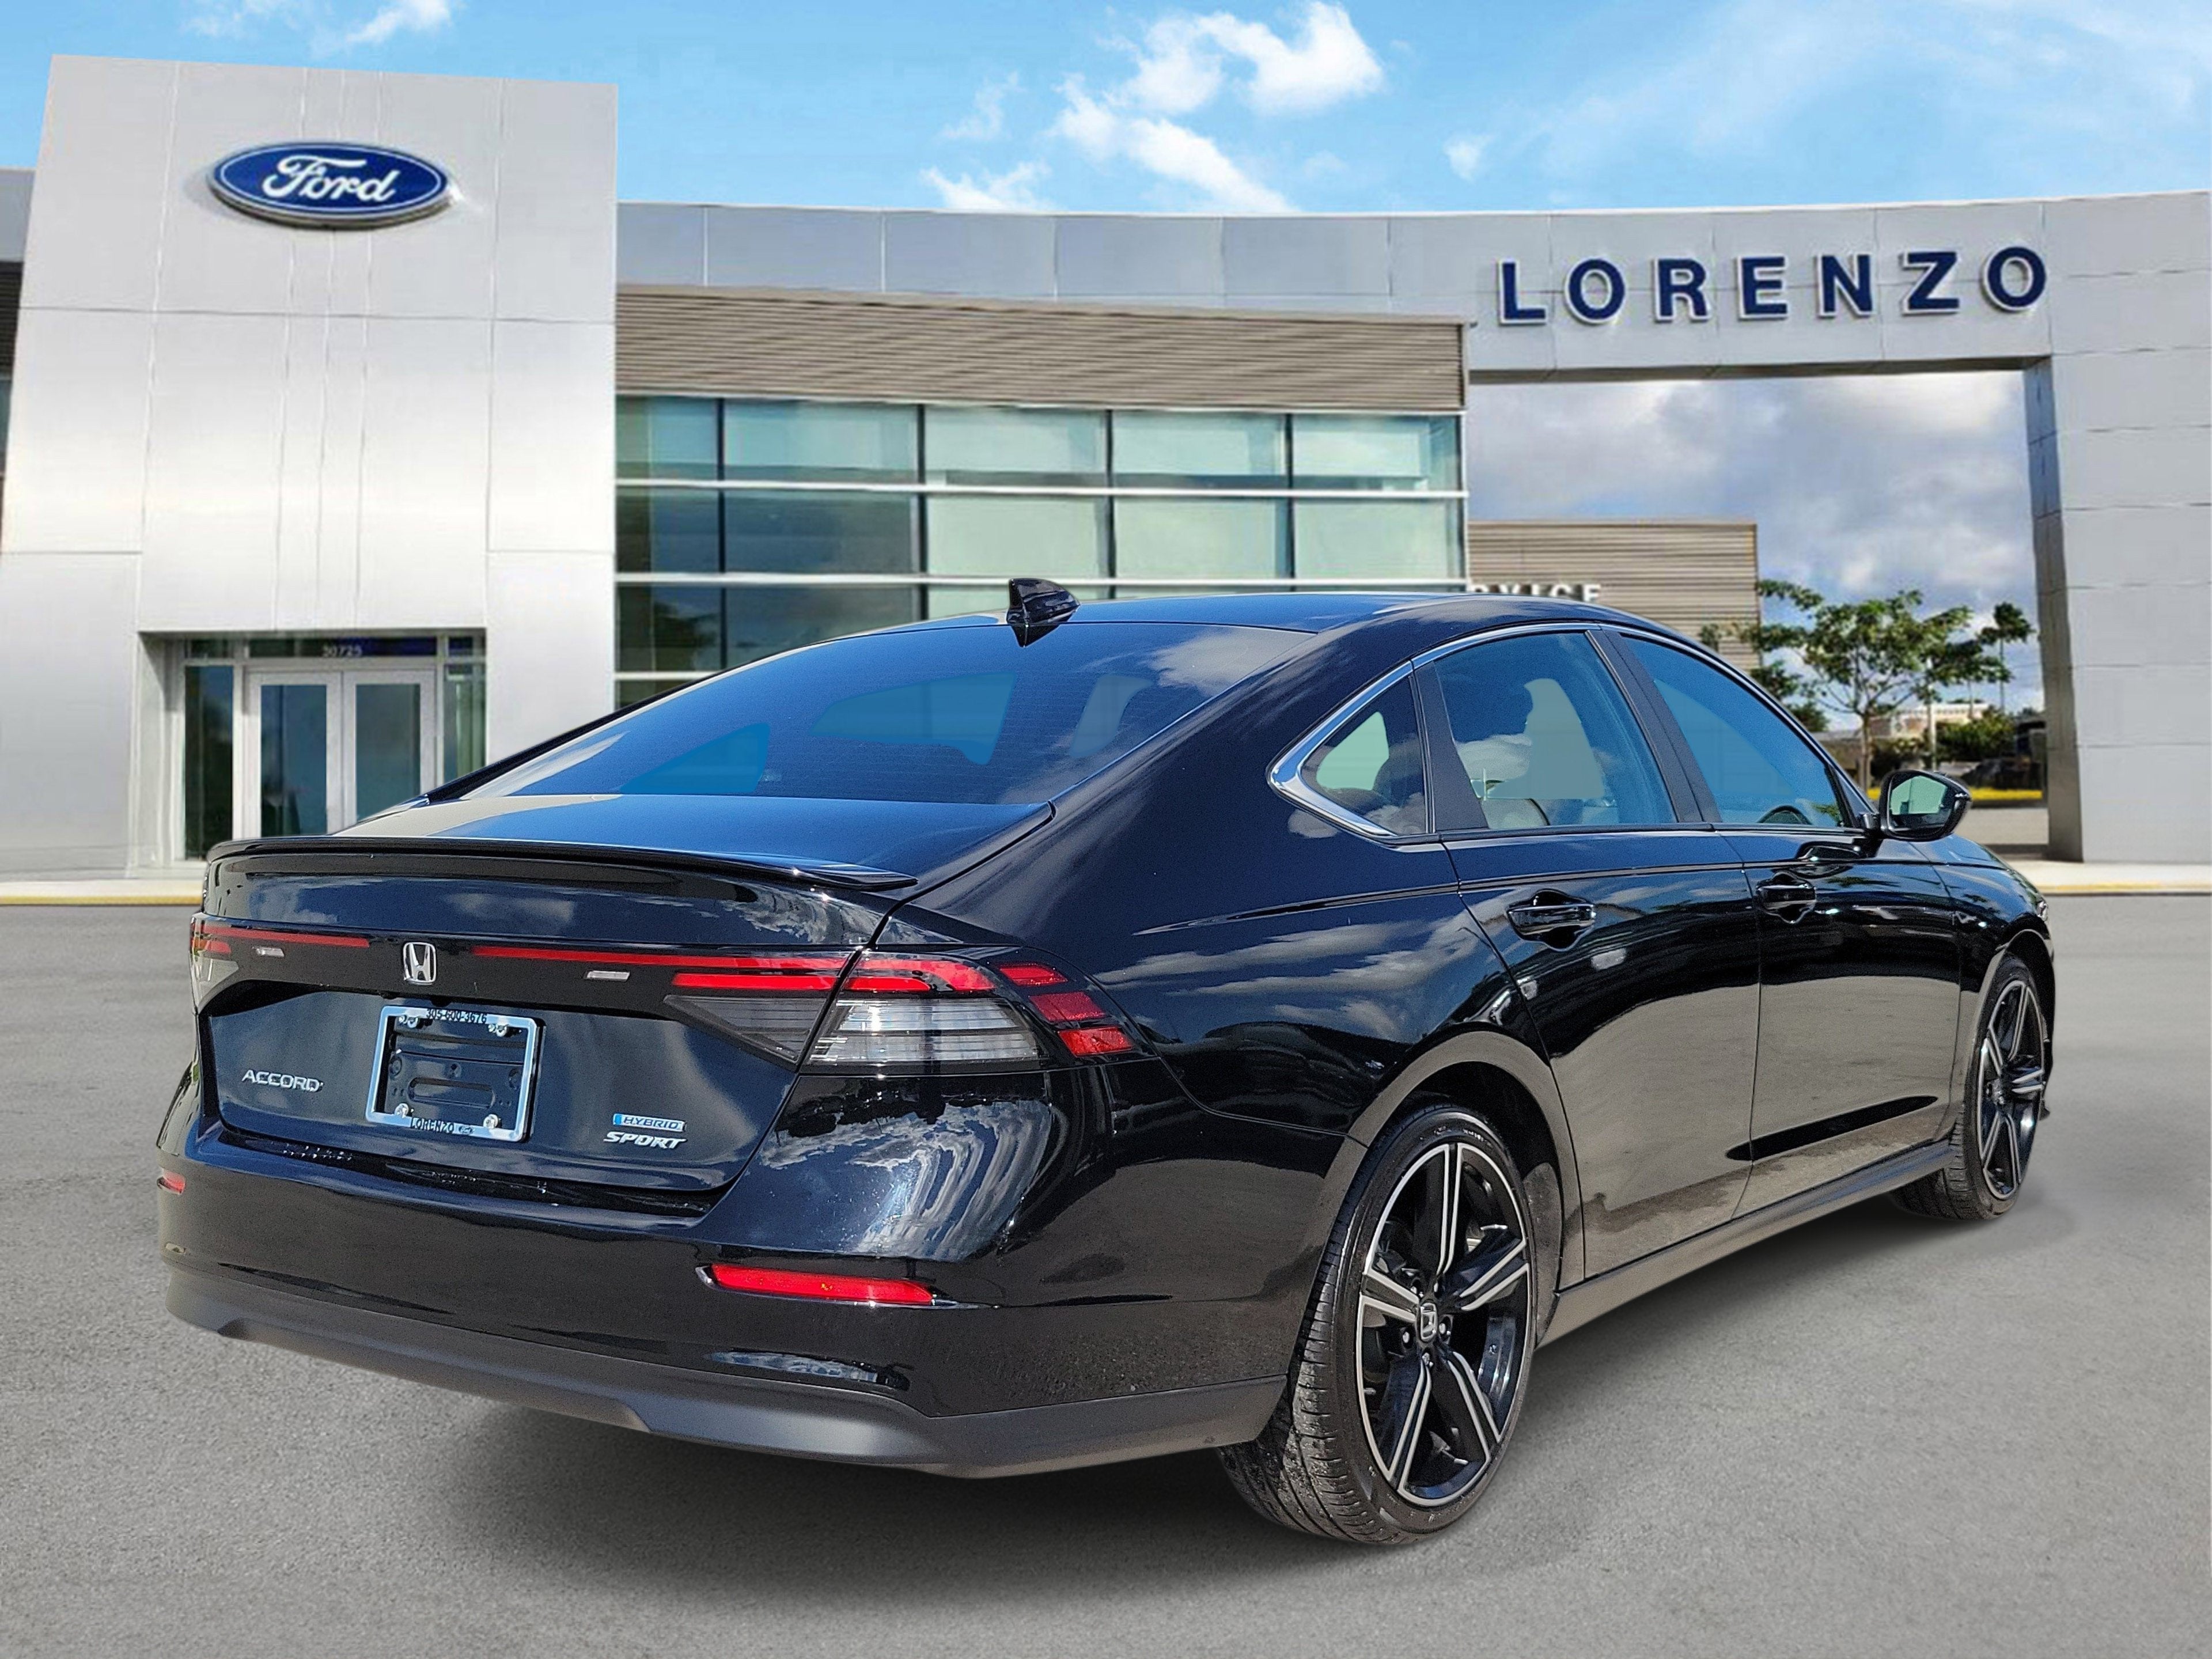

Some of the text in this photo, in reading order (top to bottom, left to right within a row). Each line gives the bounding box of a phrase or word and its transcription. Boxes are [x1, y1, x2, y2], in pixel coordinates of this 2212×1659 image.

[262, 154, 400, 202] Ford
[1498, 245, 2048, 325] LORENZO
[241, 1069, 320, 1092] ACCORD
[410, 1117, 454, 1134] LORENZO
[623, 1116, 679, 1130] HYBRID
[603, 1131, 687, 1149] SPORT
